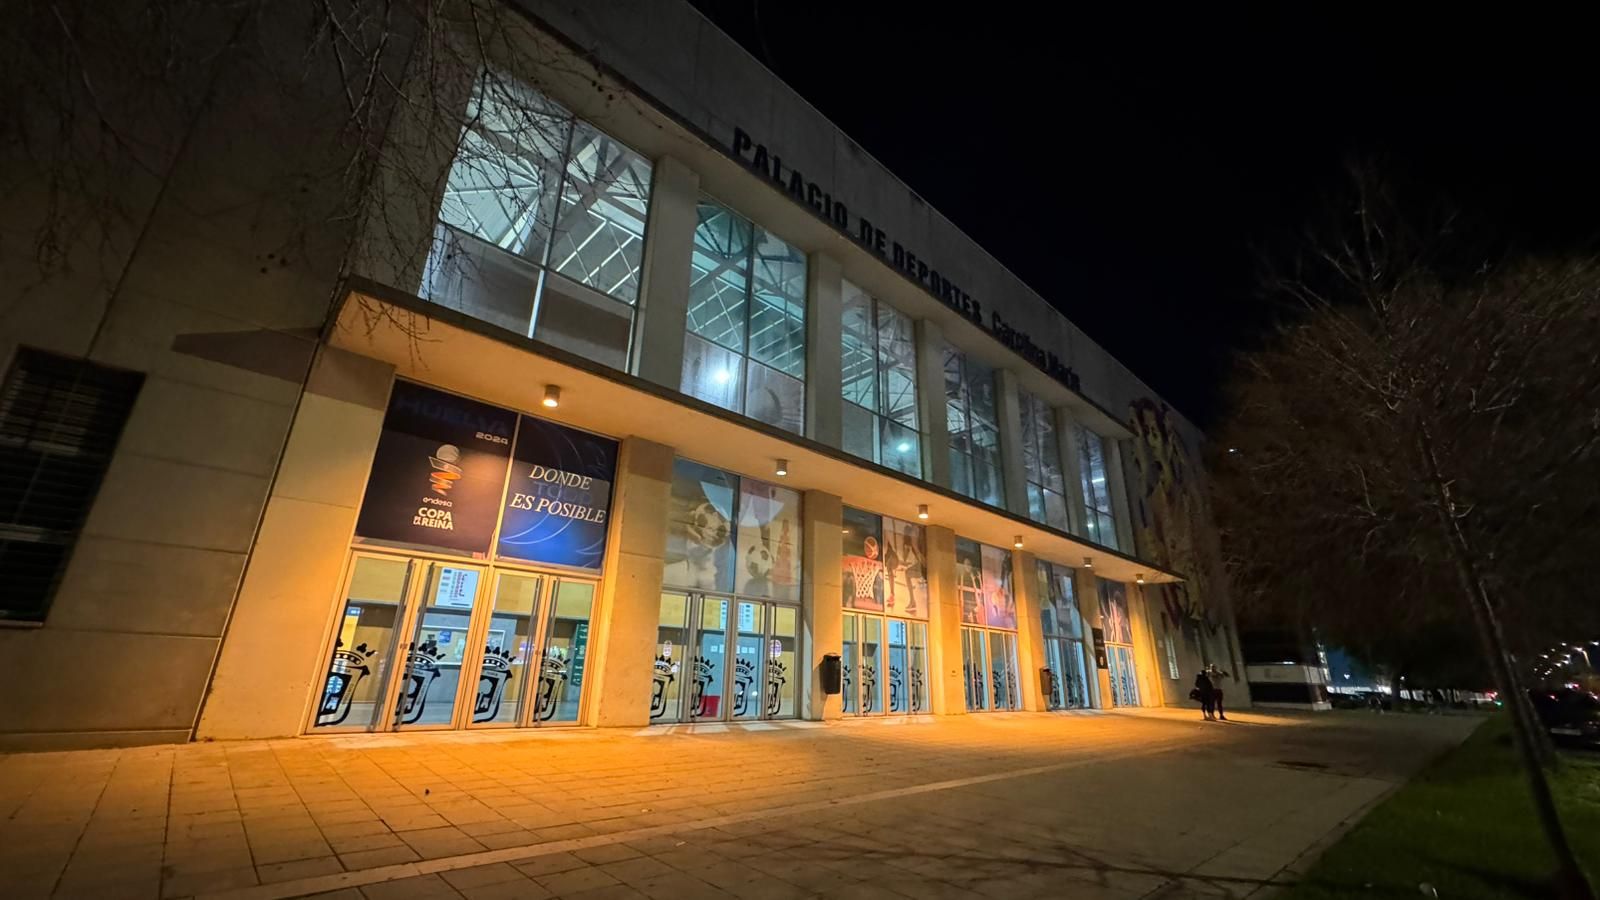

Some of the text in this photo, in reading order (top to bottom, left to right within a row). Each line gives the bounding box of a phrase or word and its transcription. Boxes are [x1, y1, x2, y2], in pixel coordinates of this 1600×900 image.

[733, 126, 849, 229] PALACIO
[859, 217, 887, 256] DE
[893, 240, 983, 324] DEPORTES
[475, 431, 509, 446] 2024
[528, 464, 593, 490] DONDE
[422, 496, 453, 508] endesa
[509, 492, 607, 525] ES POSIBLE
[418, 506, 452, 522] COPA
[421, 517, 454, 531] REINA
